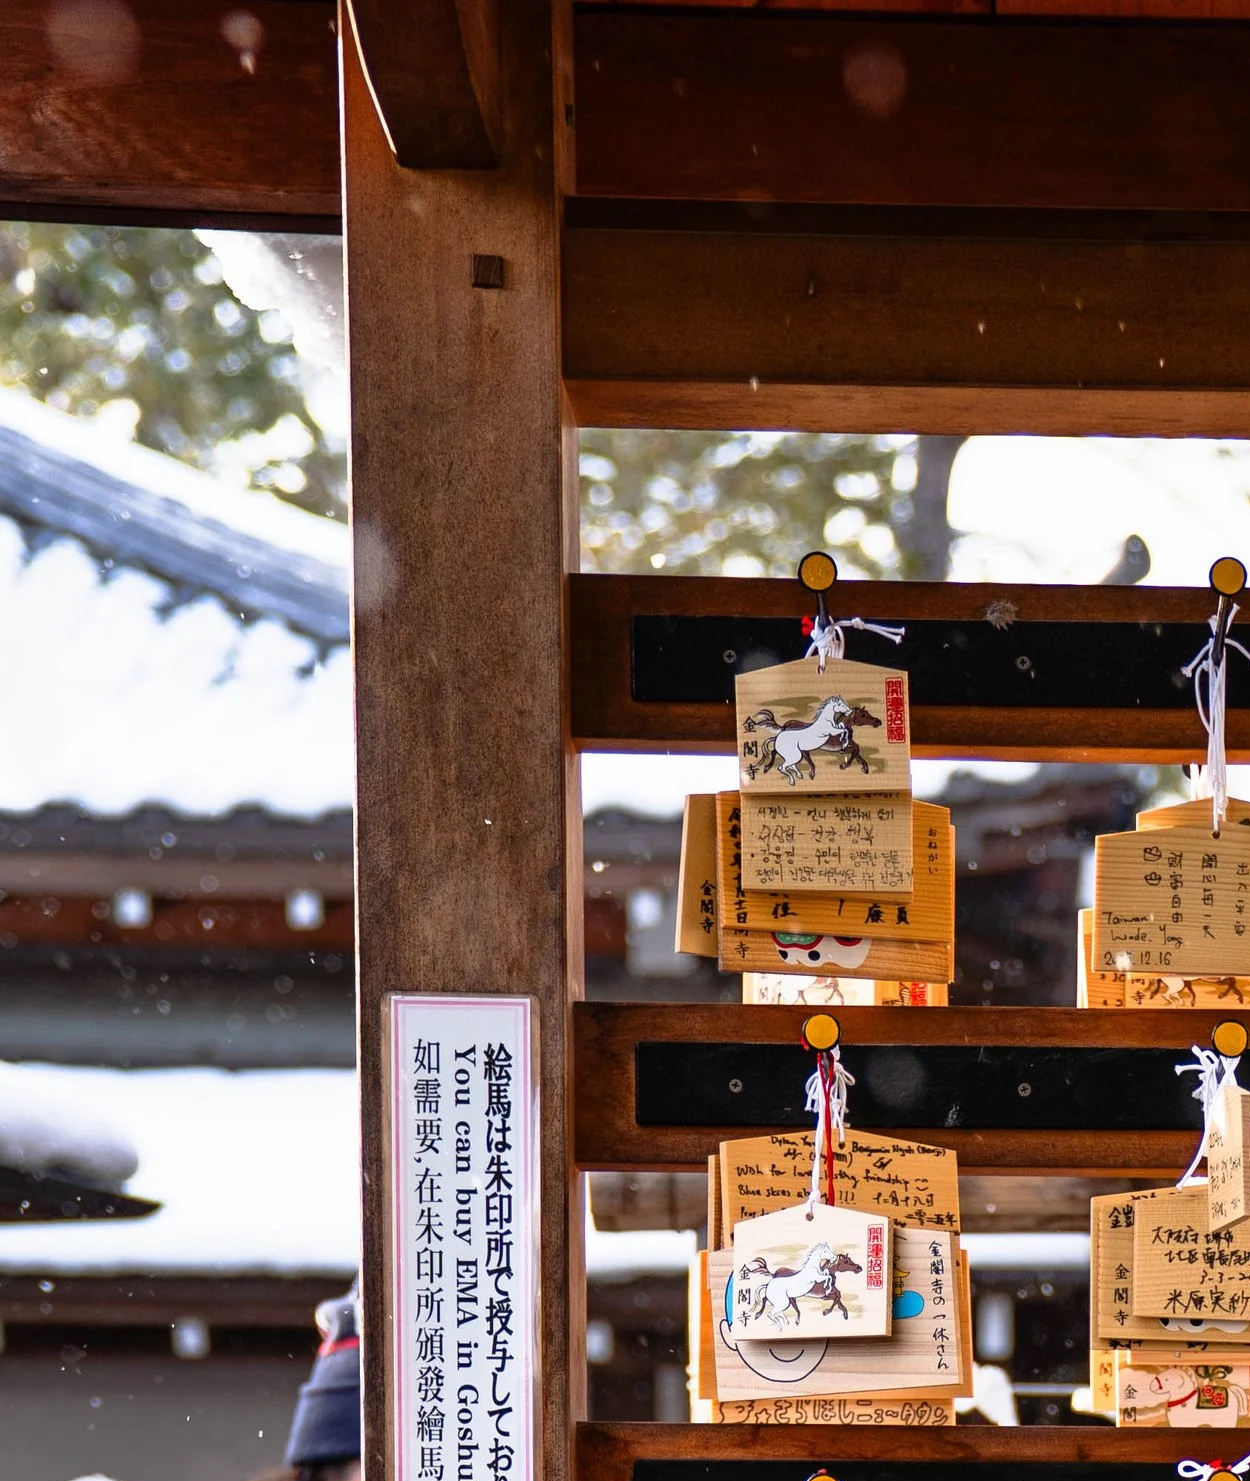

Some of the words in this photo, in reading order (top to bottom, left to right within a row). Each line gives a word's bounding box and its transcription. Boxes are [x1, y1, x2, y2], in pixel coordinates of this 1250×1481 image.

[743, 716, 759, 780] 金閣寺
[928, 828, 939, 875] おねがい
[700, 879, 716, 934] 金閣寺
[454, 1044, 476, 1103] You
[457, 1119, 472, 1175] can
[455, 1185, 476, 1246] buy
[456, 1258, 479, 1326] EMA
[738, 1264, 751, 1327] 金閣寺
[929, 1240, 950, 1370] 金閣寺の一休さん
[1114, 1264, 1129, 1326] 金閣寺
[457, 1341, 477, 1369] in
